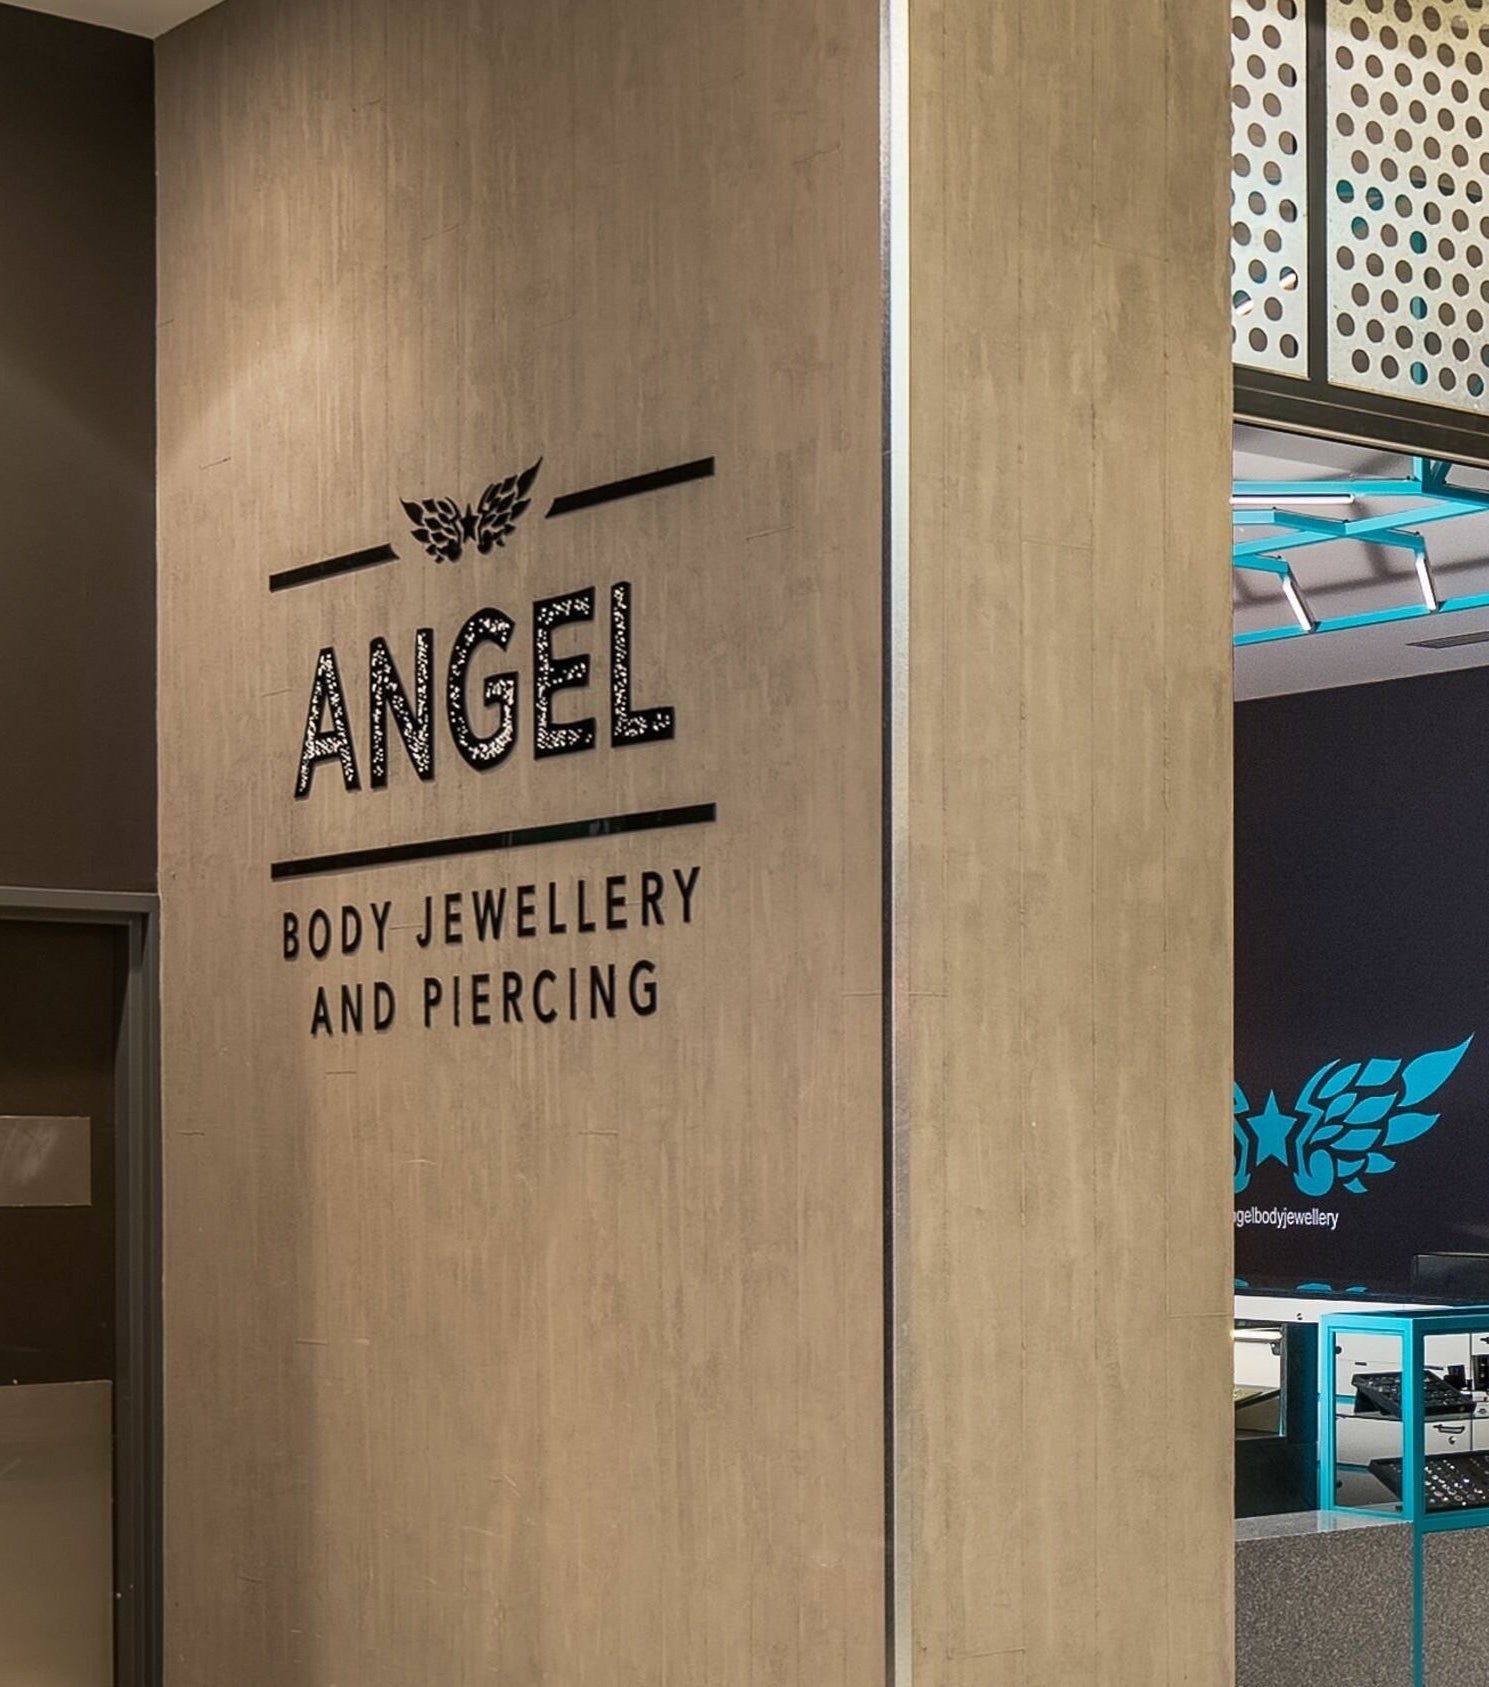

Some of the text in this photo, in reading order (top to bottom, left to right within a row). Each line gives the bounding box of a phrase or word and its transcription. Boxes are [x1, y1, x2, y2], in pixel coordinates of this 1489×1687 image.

[294, 580, 675, 800] ANGEL
[282, 866, 701, 961] BODY JEWELLERY
[310, 959, 659, 1036] AND PIERCING
